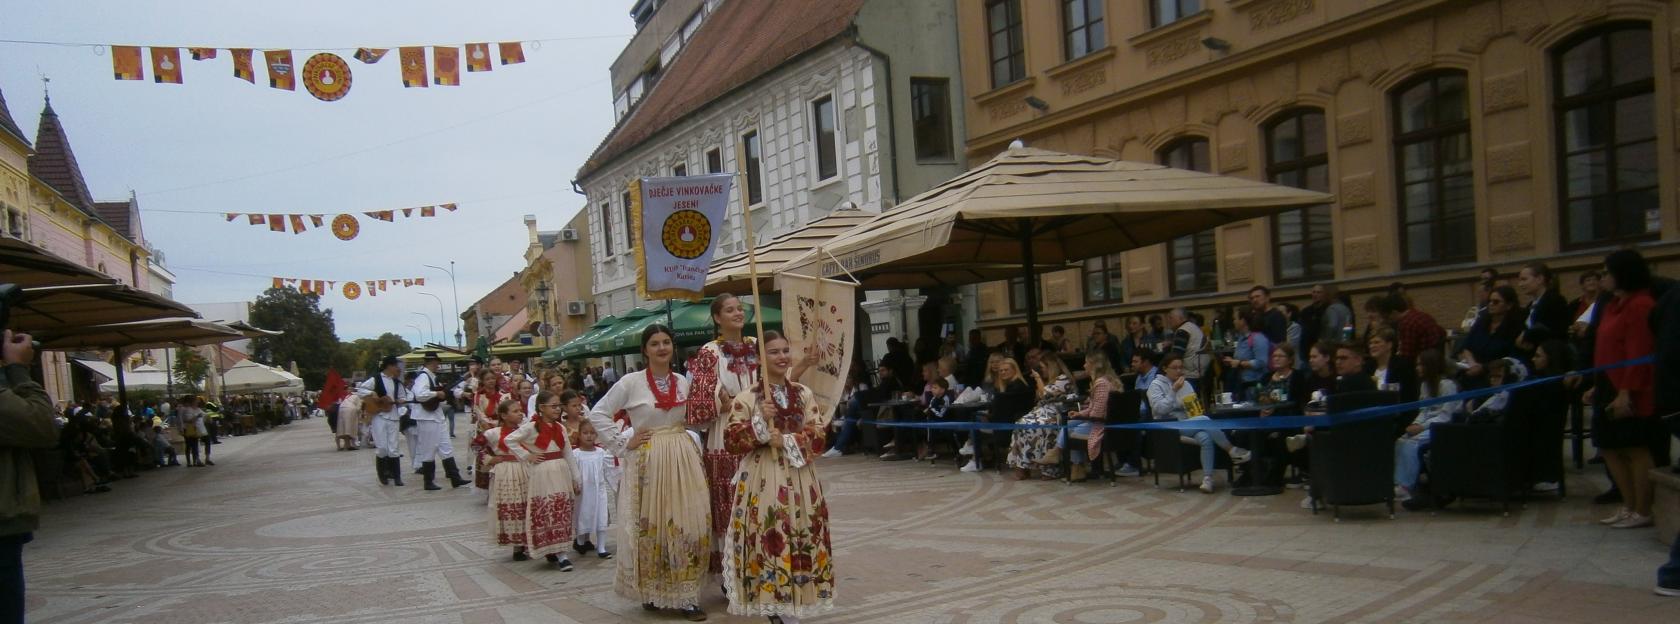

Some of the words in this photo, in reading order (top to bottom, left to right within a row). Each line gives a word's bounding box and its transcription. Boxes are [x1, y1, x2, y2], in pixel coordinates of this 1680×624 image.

[649, 186, 674, 198] DJEČJE
[677, 184, 722, 195] VINKOVAČKE
[673, 200, 699, 209] JESENI
